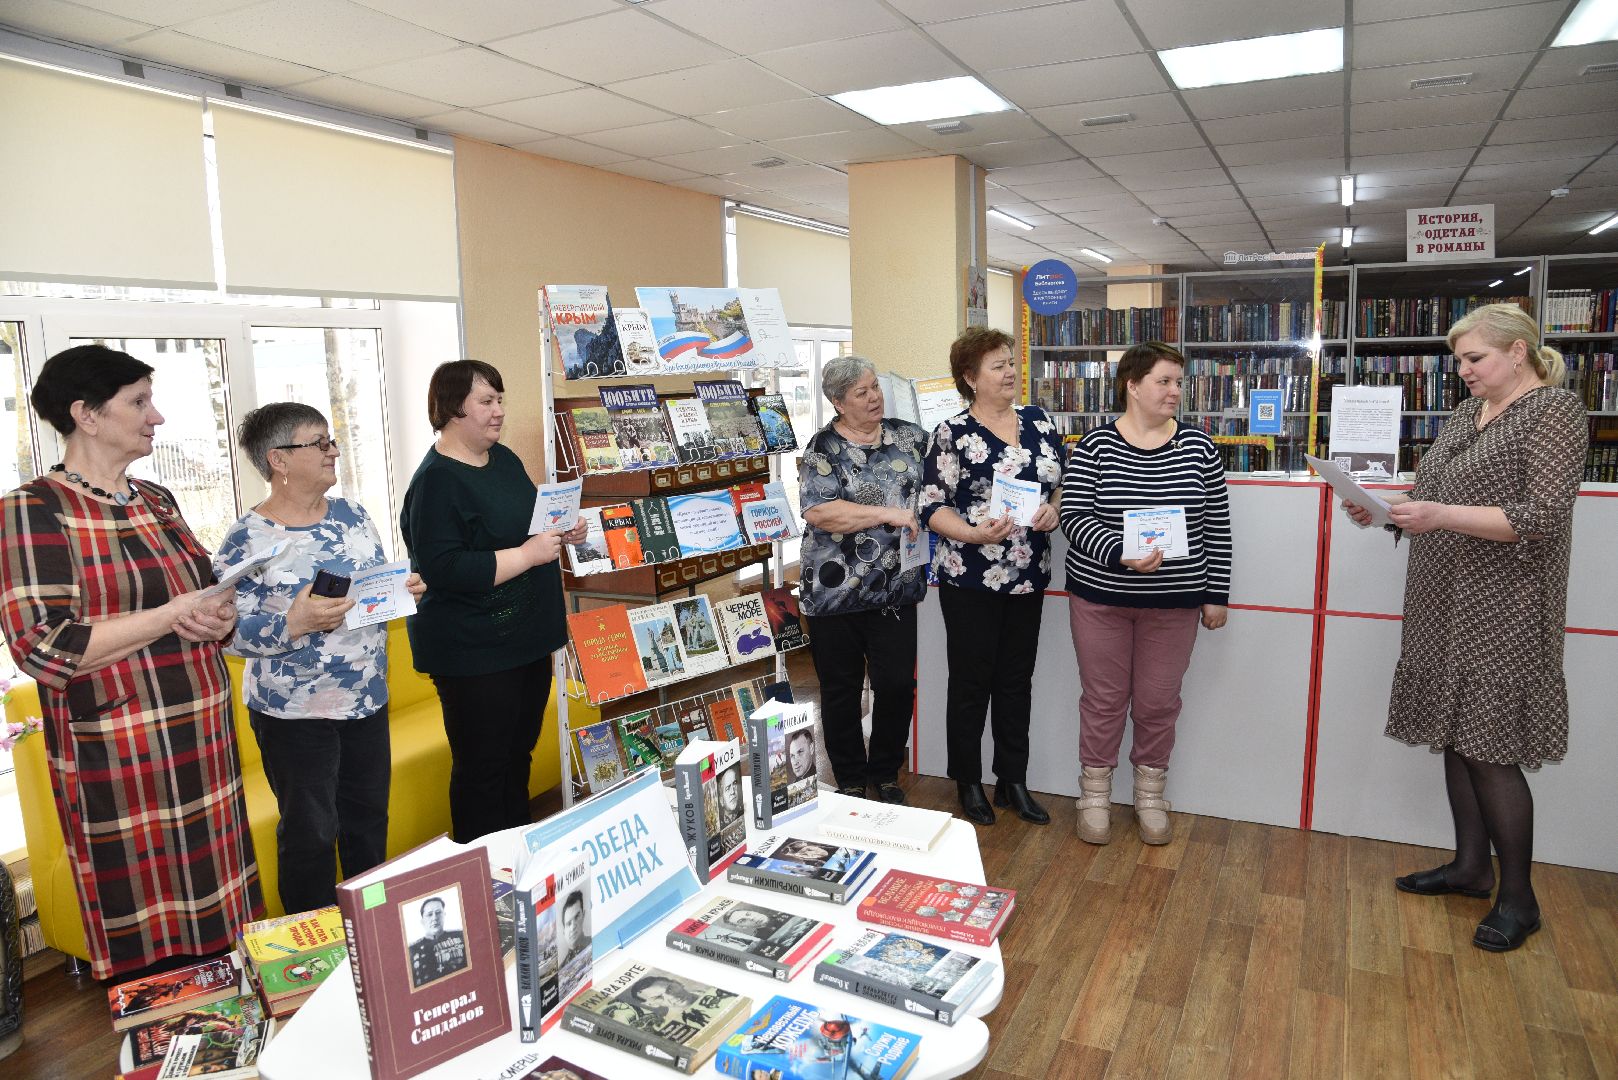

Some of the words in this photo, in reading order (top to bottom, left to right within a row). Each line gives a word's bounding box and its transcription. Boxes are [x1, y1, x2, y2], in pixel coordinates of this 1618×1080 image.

[1418, 213, 1483, 225] ИСТОРИЯ,
[1425, 228, 1476, 240] ОДЕТАЯ
[1416, 244, 1424, 253] В
[1428, 242, 1486, 253] РОМАНЫ
[555, 312, 597, 325] КРЫМ
[622, 323, 648, 332] КРЫМ
[609, 518, 632, 527] КРЫМ
[754, 517, 783, 530] РОССИЕЙ
[726, 599, 760, 613] ЧЕРНОЕ
[738, 608, 762, 621] МОРЕ
[685, 803, 697, 841] ЖУКОВ
[571, 813, 649, 866] ОБЕДА
[597, 842, 664, 903] ЛИЦАХ
[754, 875, 804, 895] ПОКРЫШКИН
[518, 937, 529, 962] ЧУЙКОВ
[695, 945, 716, 960] КРЫЛОВ
[521, 962, 533, 990] ВАСИЛИЙ
[580, 982, 620, 1010] РИХАРД
[617, 963, 646, 987] ЗОРГЕ
[413, 990, 477, 1027] Генерал
[411, 1005, 484, 1045] Сандалов
[755, 1004, 802, 1045] Неизвестный
[769, 1009, 819, 1051] КОЖЕДУБ
[596, 1027, 614, 1044] ЗОРГЕ
[615, 1034, 643, 1051] РИХАРД
[864, 1032, 897, 1058] Служу
[877, 1036, 911, 1065] Родине
